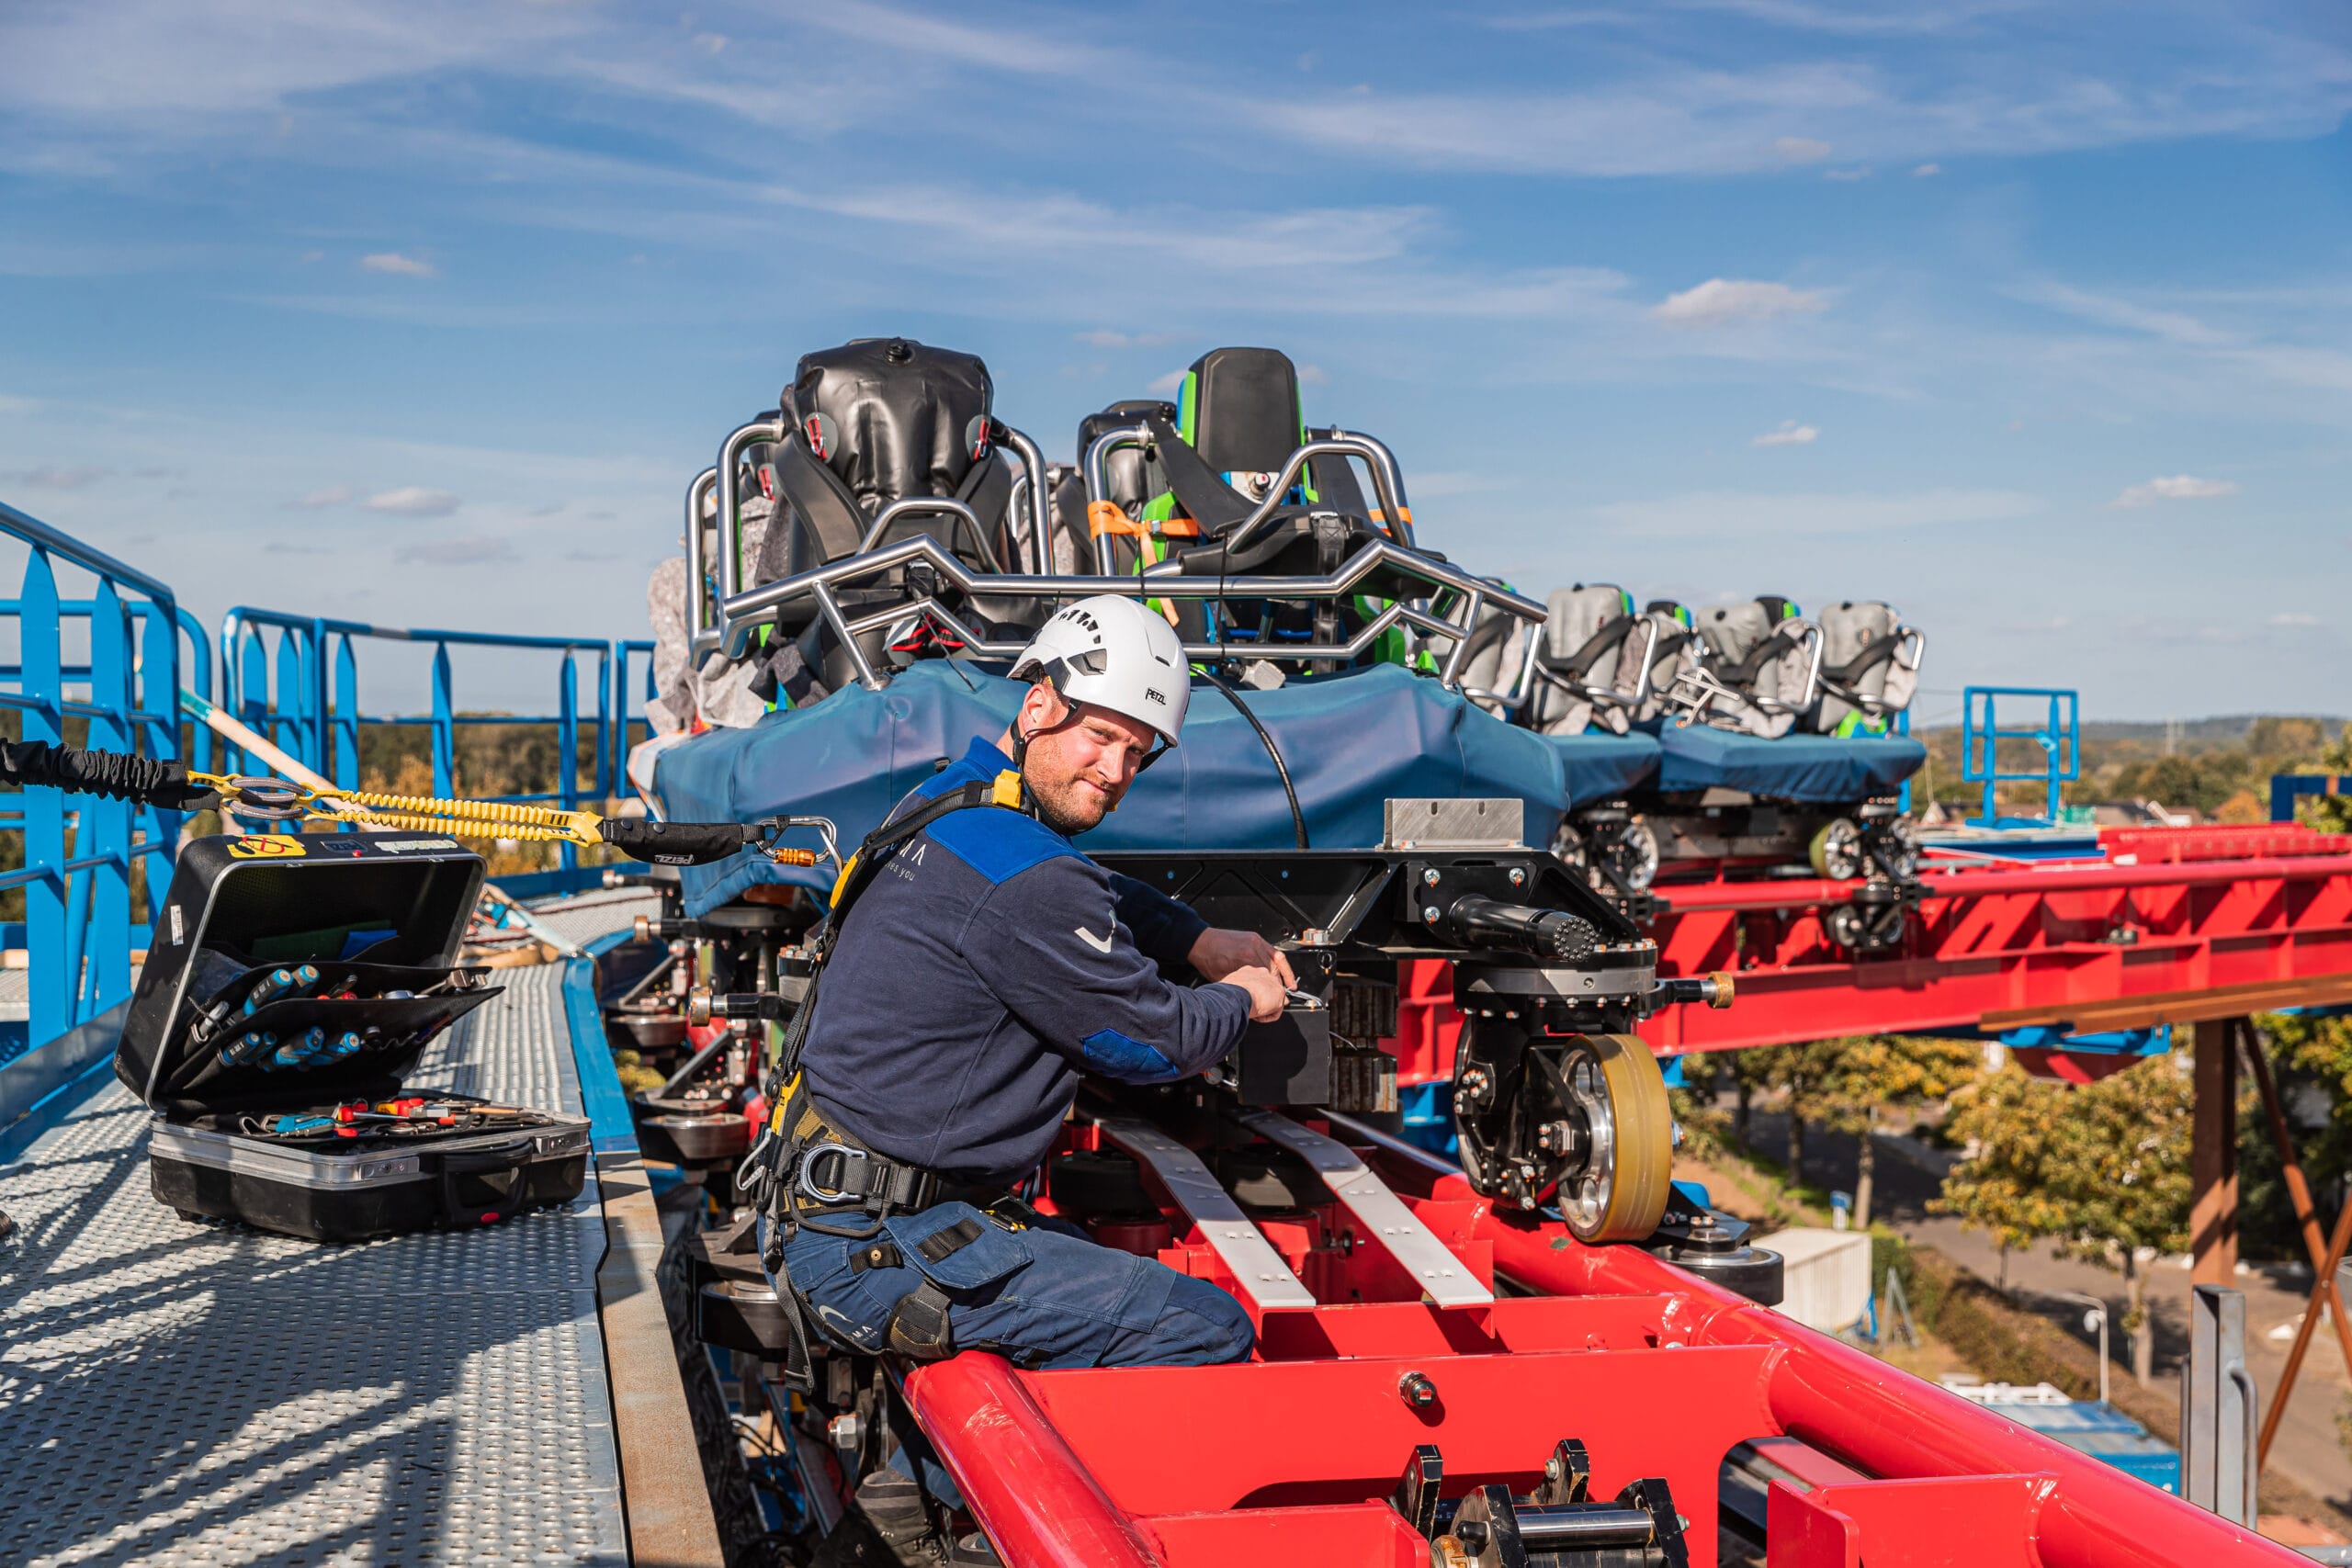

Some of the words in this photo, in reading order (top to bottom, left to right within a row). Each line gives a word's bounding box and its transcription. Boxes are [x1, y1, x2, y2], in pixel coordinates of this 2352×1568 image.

[1145, 687, 1167, 705] PETZL
[654, 854, 695, 865] PETZL
[899, 867, 916, 881] you
